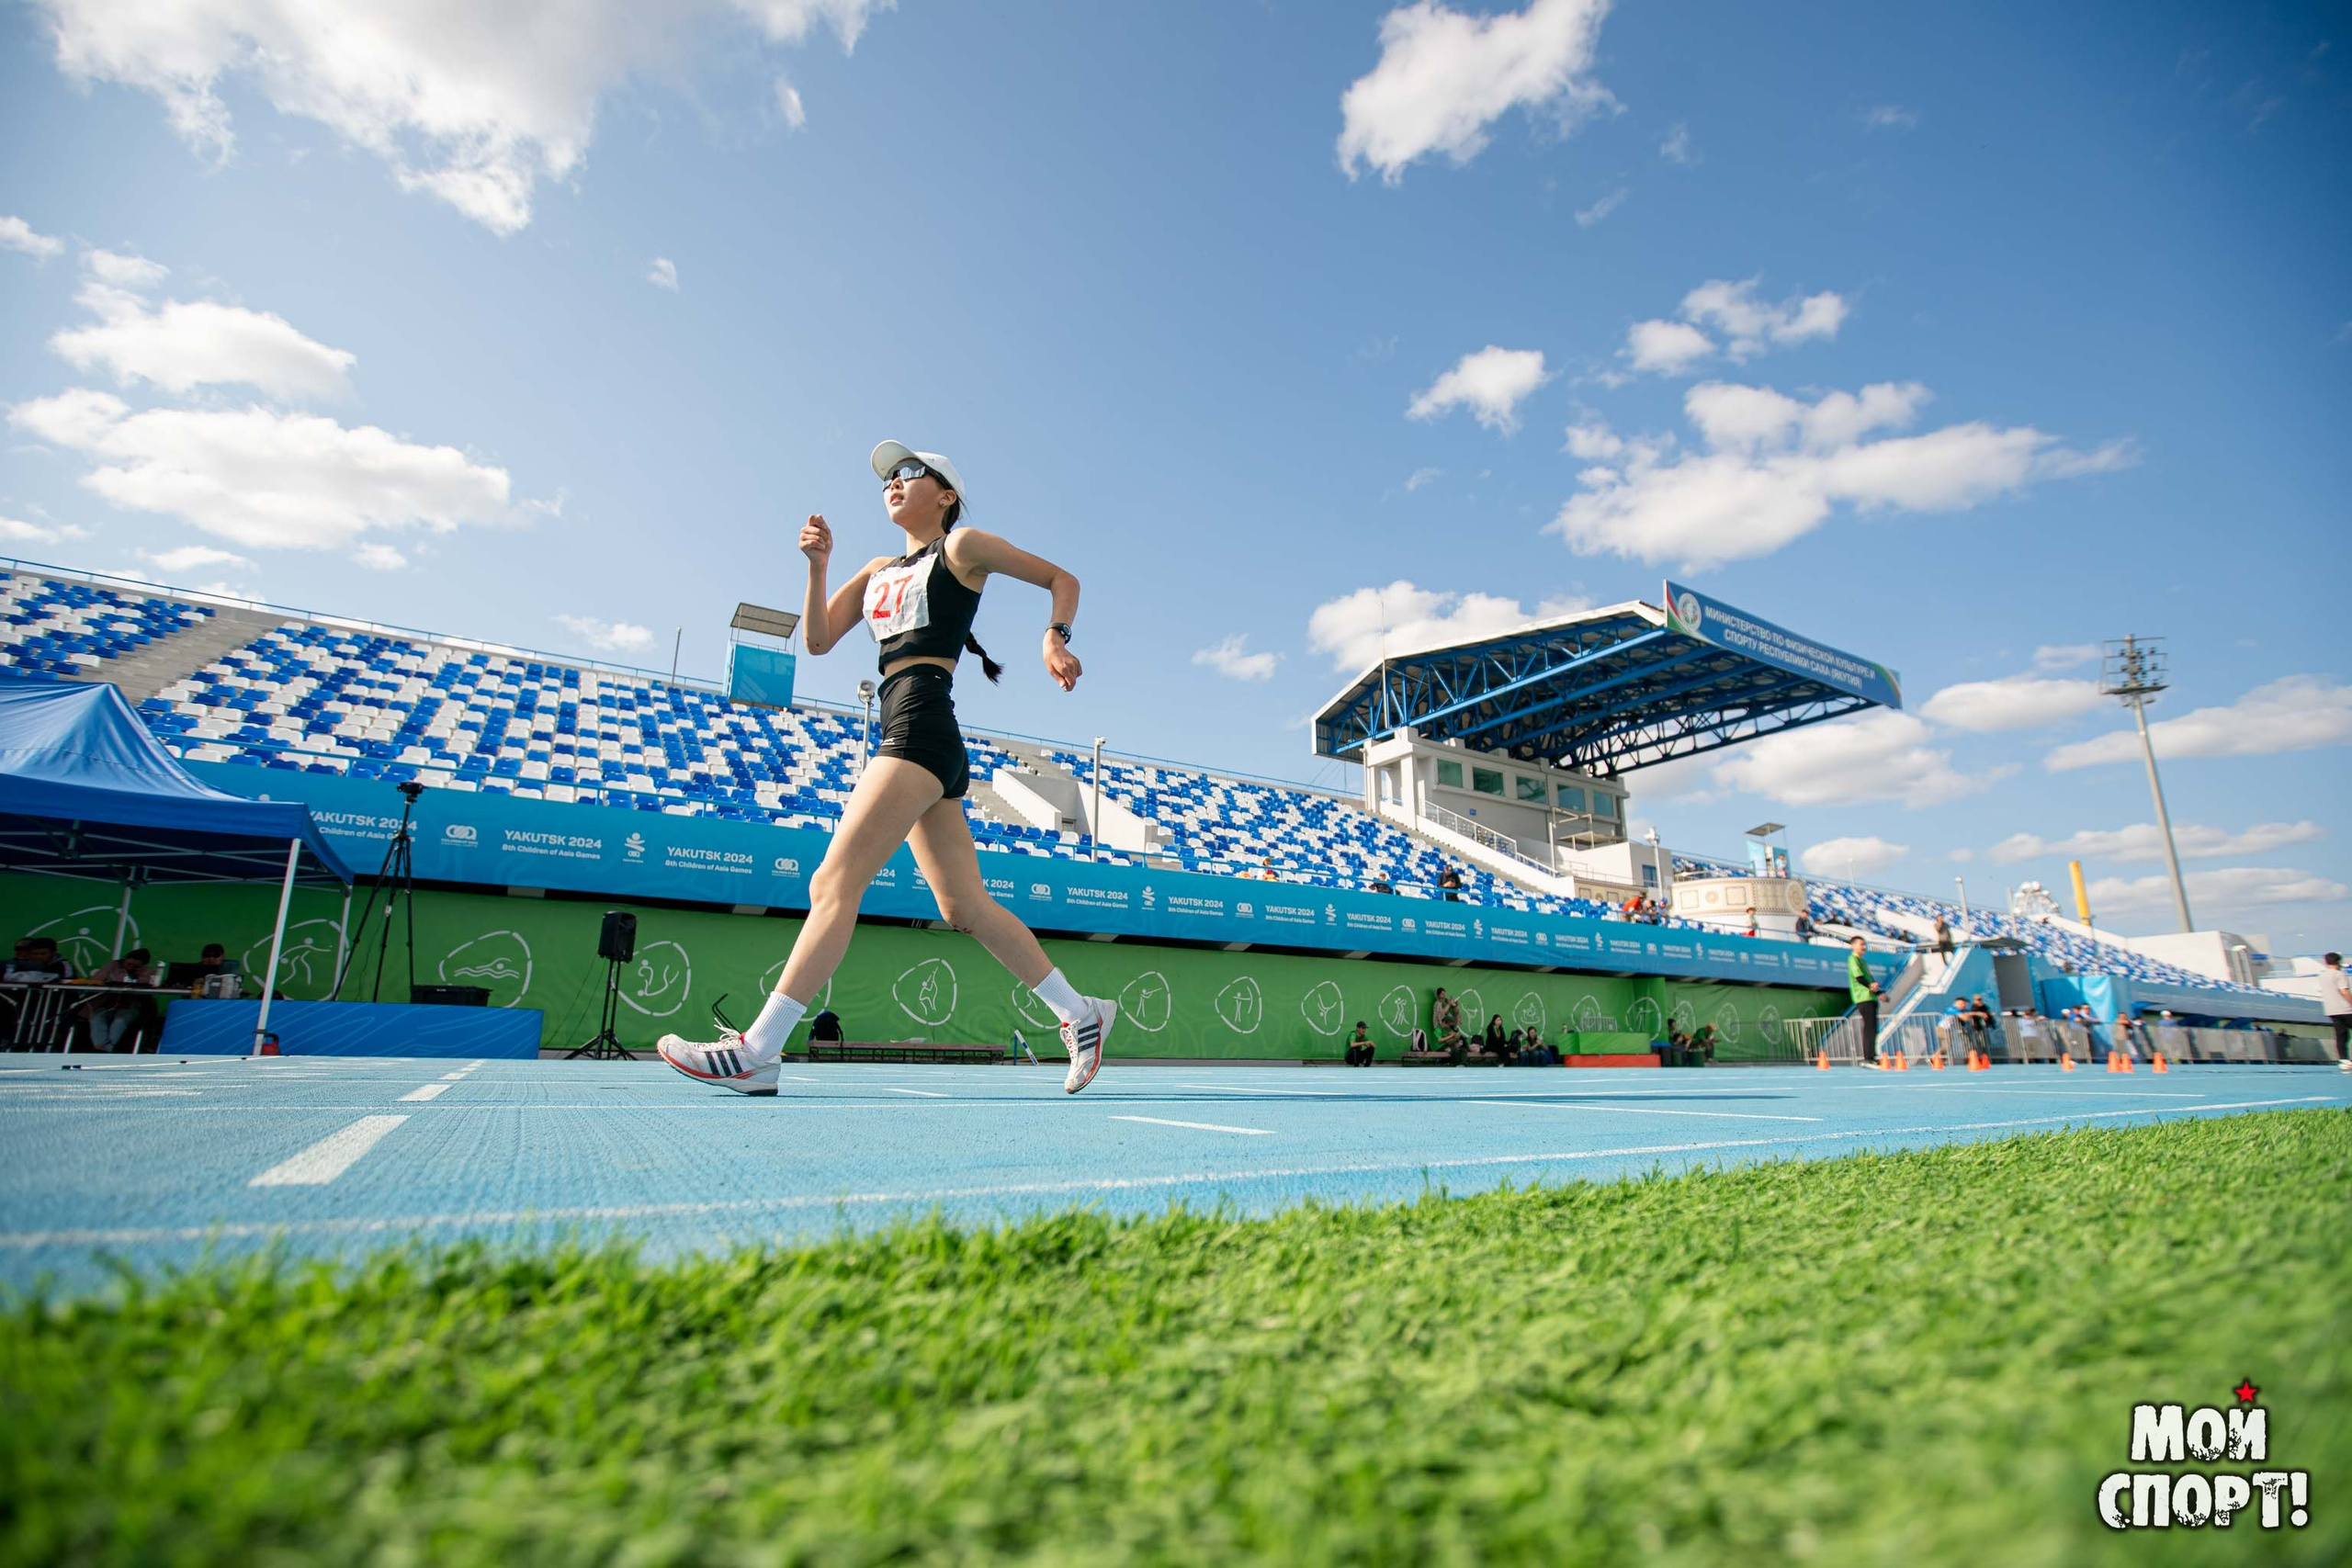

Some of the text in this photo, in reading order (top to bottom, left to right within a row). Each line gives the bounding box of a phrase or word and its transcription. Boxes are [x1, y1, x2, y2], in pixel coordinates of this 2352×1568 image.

[873, 574, 913, 619] 27
[1705, 605, 1772, 643] МИНИСТЕРСТВО
[1772, 632, 1785, 647] ПО
[1785, 636, 1836, 665] ФИЗИЧЕСКОЙ
[1836, 654, 1870, 677] КУЛЬТУРЕ
[1724, 628, 1758, 650] СПОРТУ
[1758, 641, 1810, 669] РЕСПУБЛИКИ
[1810, 659, 1832, 677] САХА
[319, 827, 356, 838] Children
[367, 831, 386, 840] Asia
[504, 830, 602, 849] YAKUTSK 2024
[502, 844, 601, 860] 8th Children of Asia Games
[667, 846, 753, 864] YAKUTSK 2024
[678, 861, 706, 870] Children
[715, 864, 729, 873] Asia
[730, 865, 752, 874] Games
[990, 879, 1014, 889] 2024
[1067, 886, 1128, 900] YAKUTSK 2024
[1076, 898, 1095, 907] Children
[1169, 897, 1224, 908] YAKUTSK 2024
[1265, 906, 1315, 917] YAKUTSK 2024
[1347, 912, 1392, 924] YAKUTSK 2024
